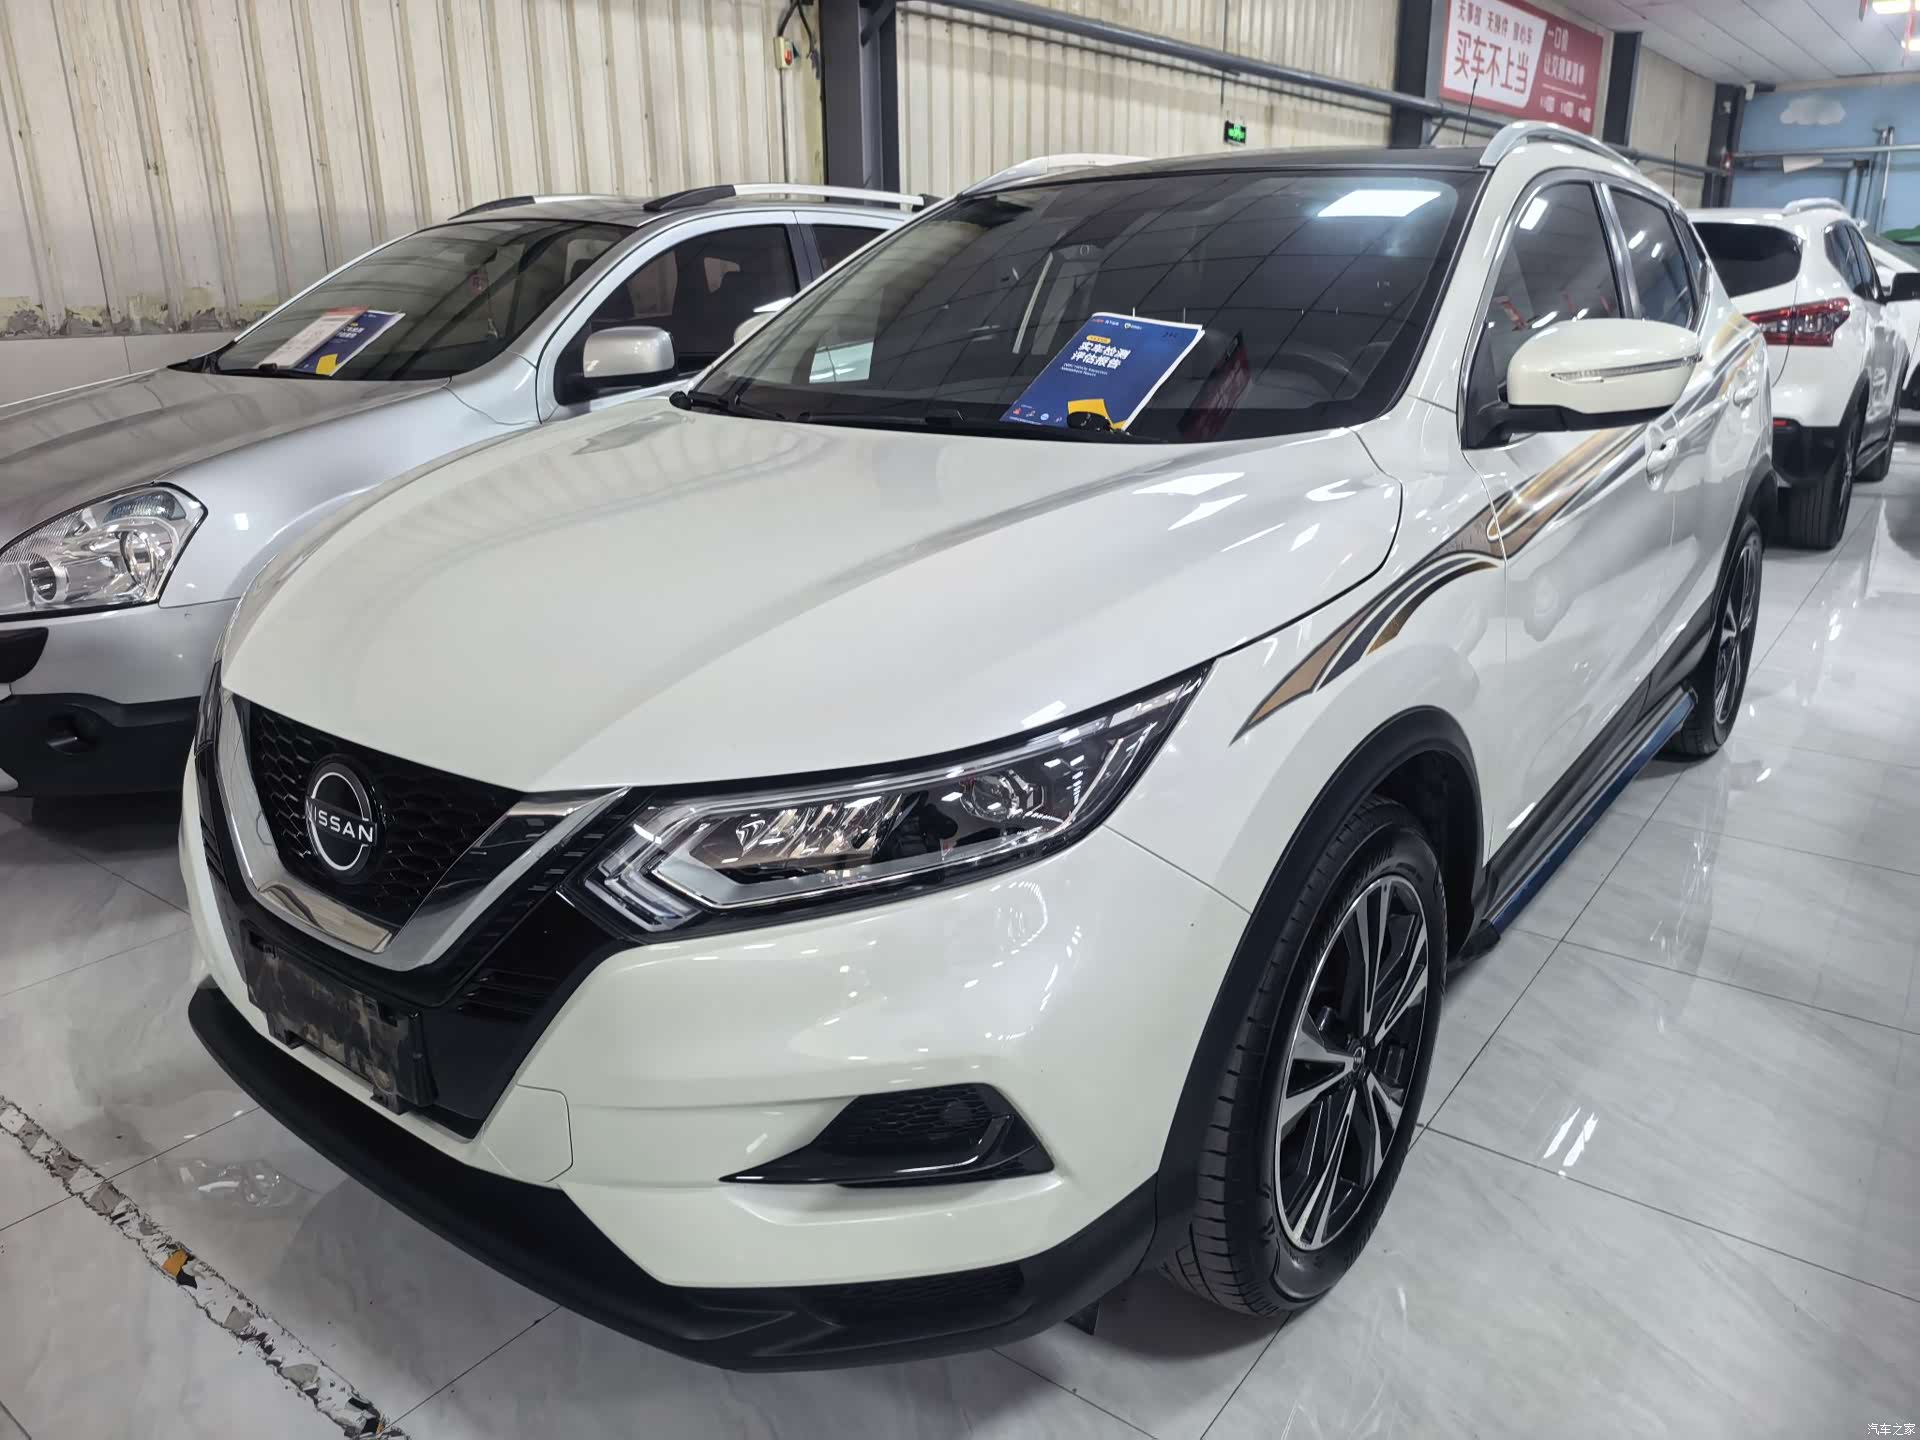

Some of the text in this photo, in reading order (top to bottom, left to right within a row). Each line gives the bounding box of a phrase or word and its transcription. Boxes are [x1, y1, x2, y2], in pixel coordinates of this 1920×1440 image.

[1454, 29, 1529, 94] 买车不上当
